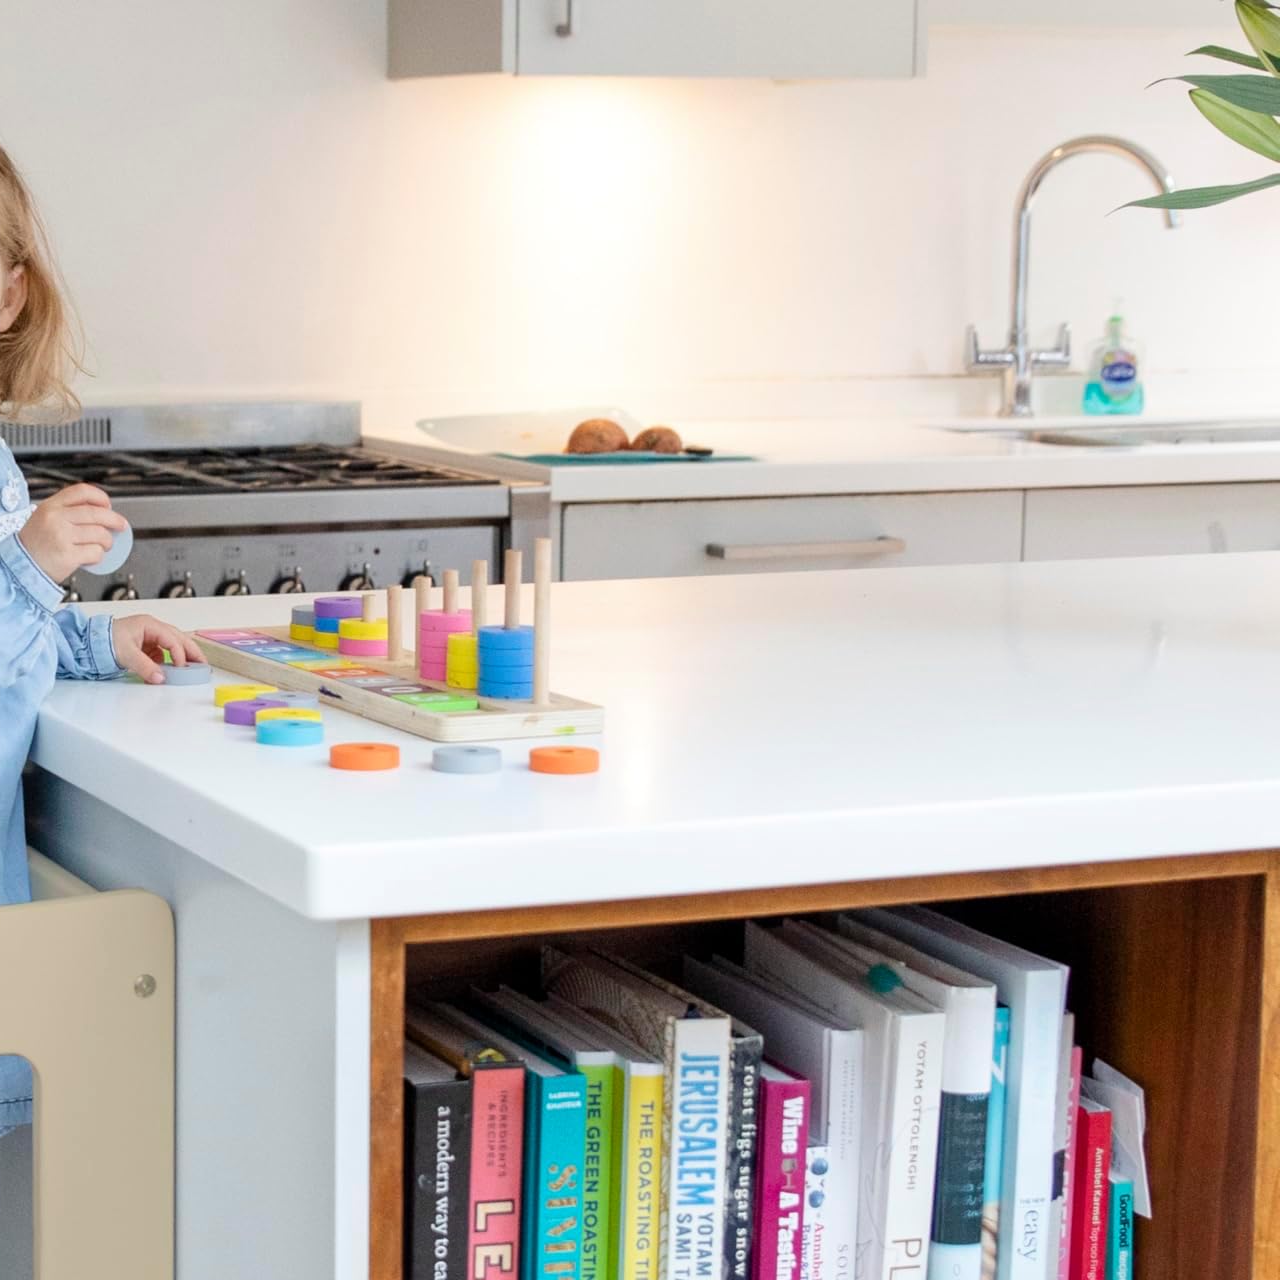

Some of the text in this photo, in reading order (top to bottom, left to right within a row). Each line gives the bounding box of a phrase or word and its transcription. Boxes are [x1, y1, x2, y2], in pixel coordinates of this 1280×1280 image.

[437, 1105, 451, 1117] a
[587, 1081, 602, 1119] THE
[640, 1101, 655, 1138] THE
[781, 1096, 805, 1155] Wine
[907, 1041, 928, 1190] YOTAM OTTOLENGHI
[486, 1114, 497, 1168] RECIPES
[497, 1090, 509, 1178] INGREDIENTS
[676, 1052, 720, 1206] JERUSALEM
[436, 1119, 455, 1193] modern
[585, 1127, 601, 1193] GREEN
[734, 1065, 757, 1277] roast figs sugar snow
[1093, 1147, 1105, 1187] Annabel
[431, 1196, 450, 1236] way
[636, 1146, 654, 1251] ROASTING
[778, 1191, 800, 1211] A
[1091, 1189, 1102, 1225] Karmel
[1119, 1194, 1130, 1247] GoodFood
[434, 1238, 449, 1259] to
[674, 1212, 693, 1260] SAMI
[695, 1212, 715, 1276] YOTAM
[1017, 1209, 1040, 1262] easy
